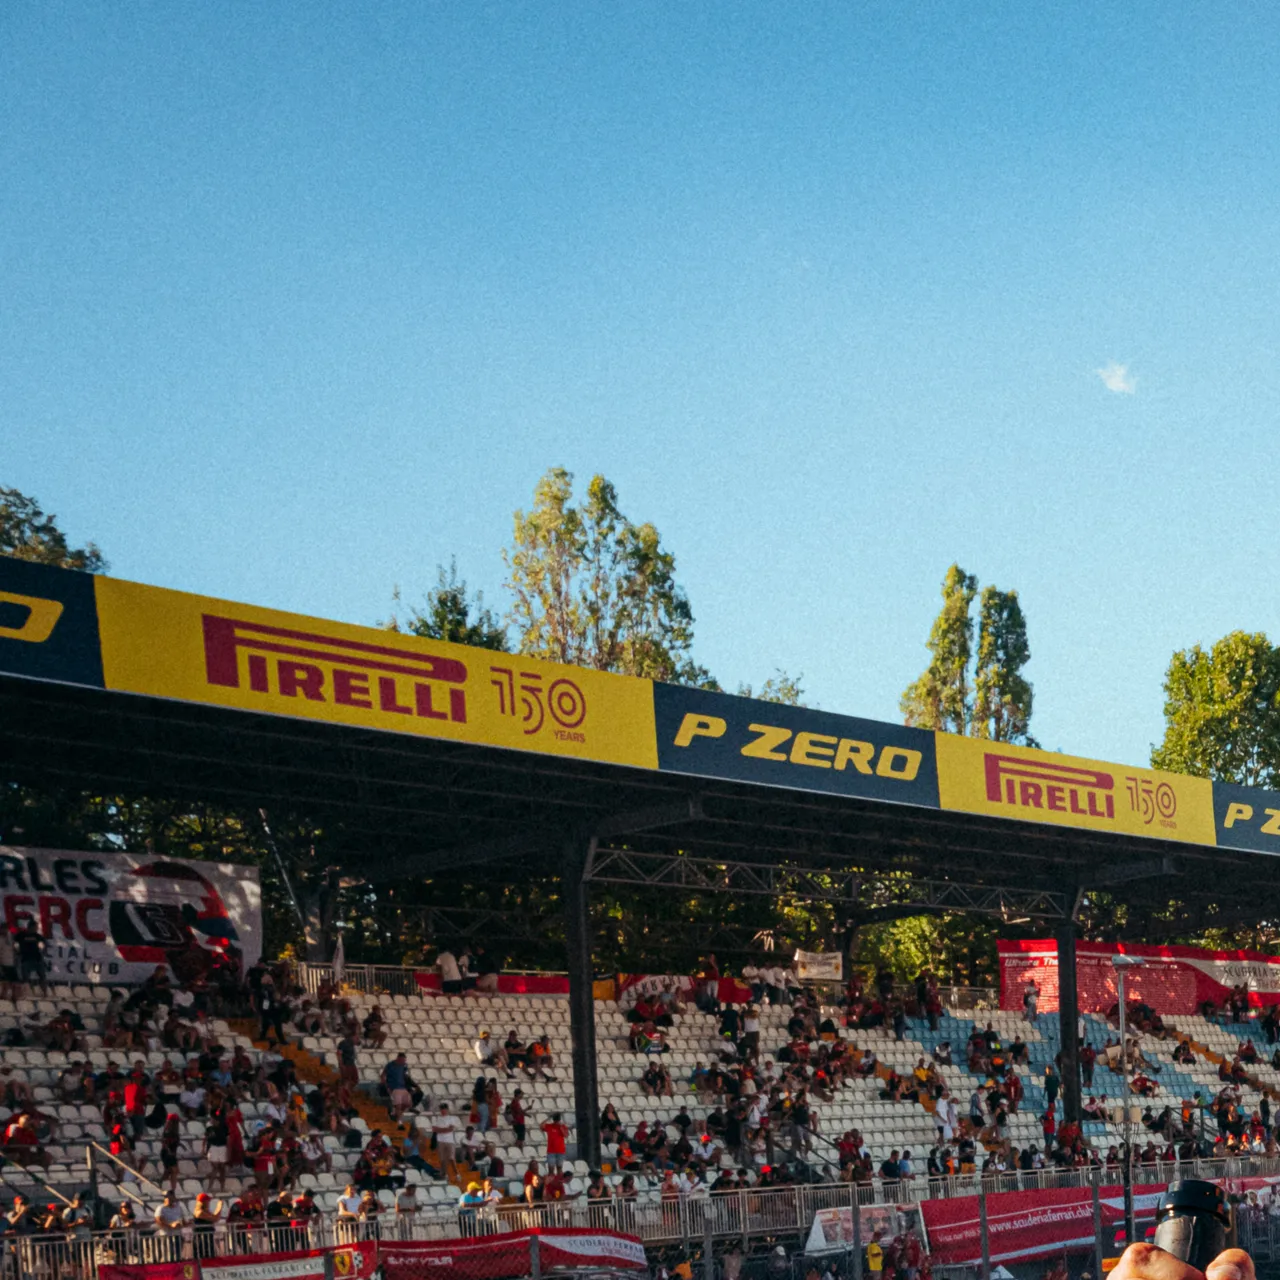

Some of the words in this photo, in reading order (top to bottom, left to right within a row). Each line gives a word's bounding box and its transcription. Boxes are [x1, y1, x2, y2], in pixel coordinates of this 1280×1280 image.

[202, 613, 468, 724] PIRELLI
[490, 666, 587, 735] 150
[553, 730, 586, 743] YEARS
[675, 713, 728, 748] P
[740, 723, 922, 781] ZERO
[984, 753, 1114, 819] PIRELLI
[1126, 776, 1176, 826] 150
[1224, 803, 1254, 829] P
